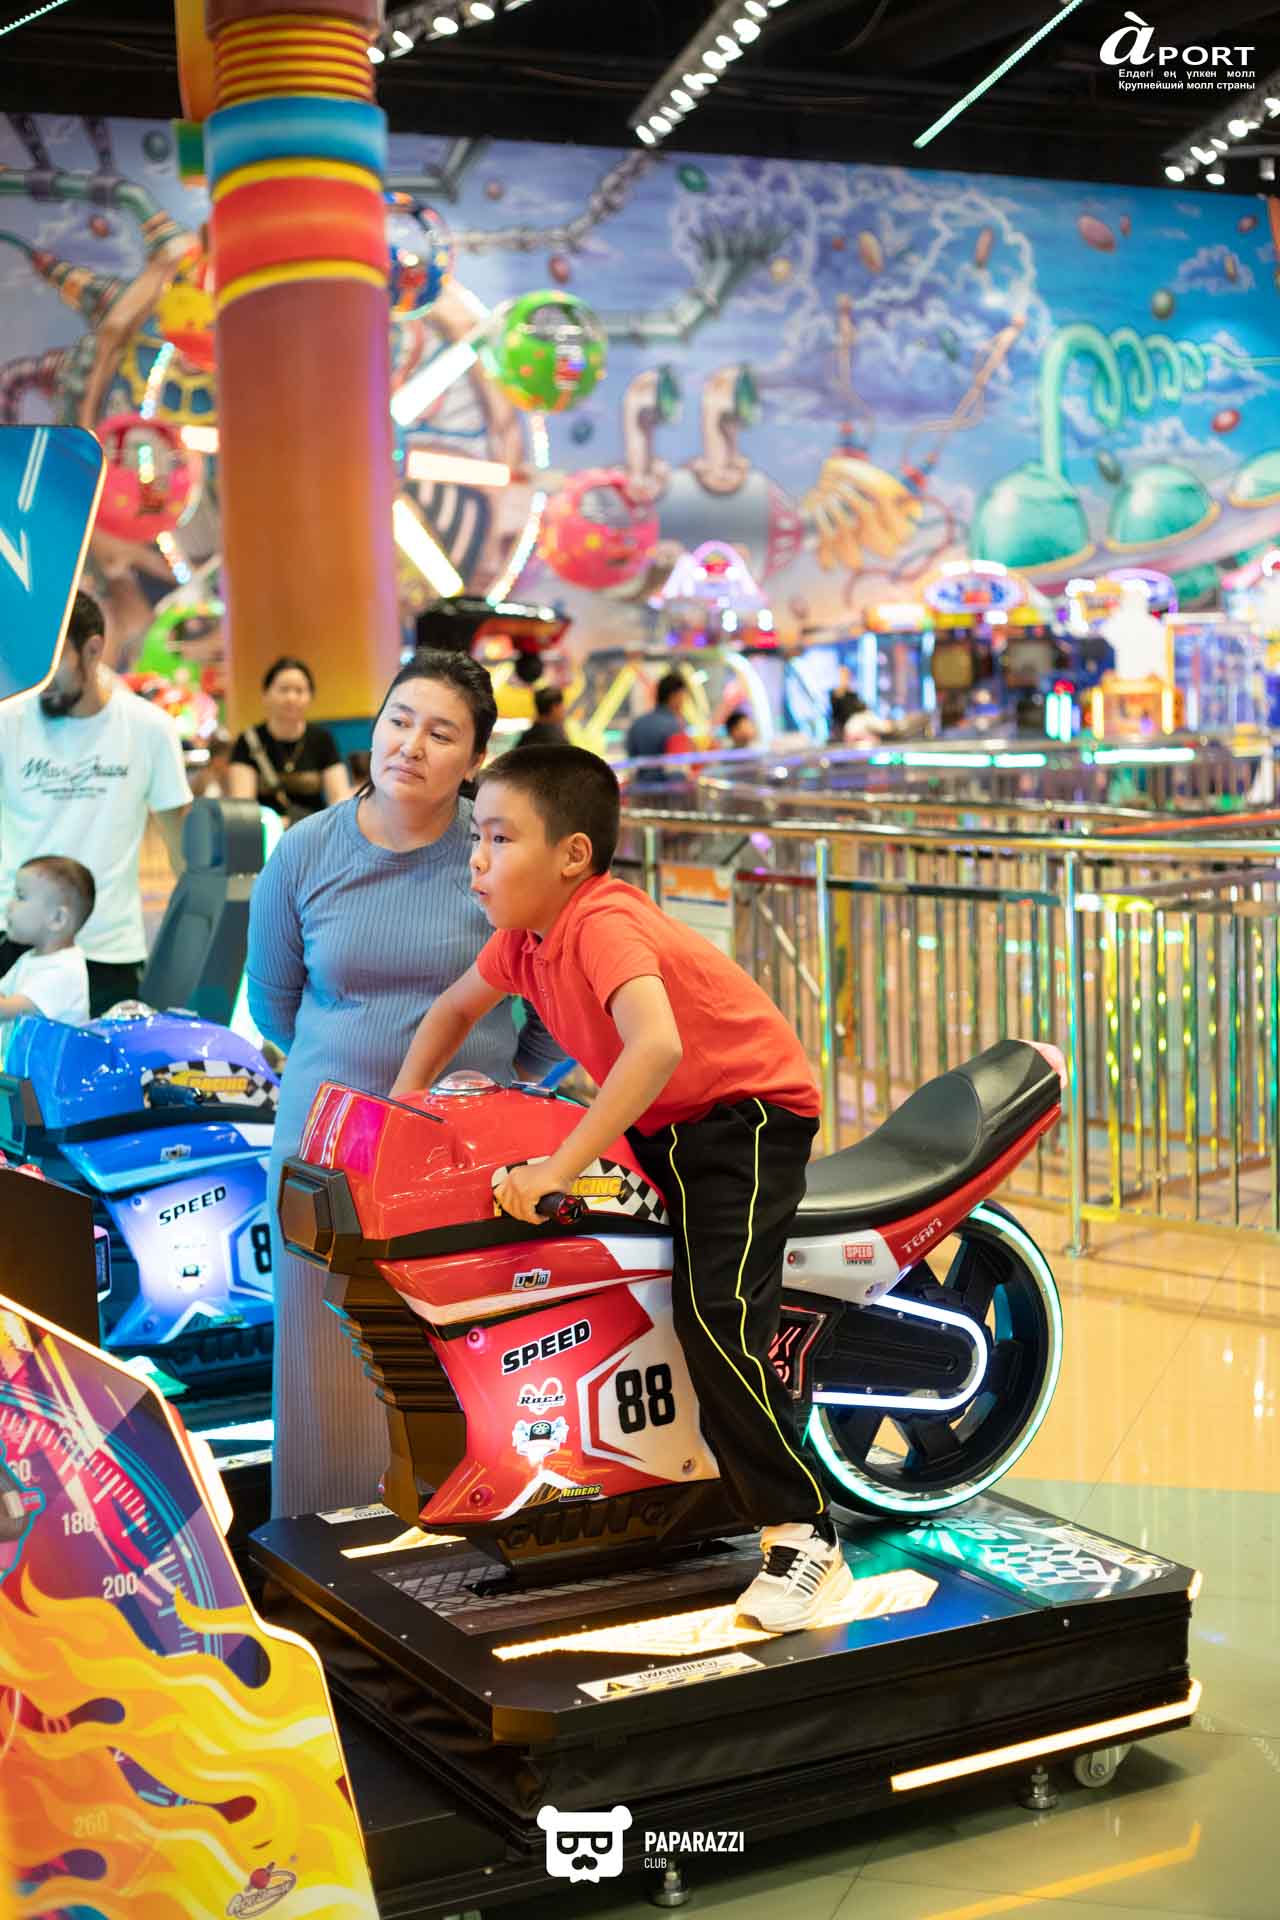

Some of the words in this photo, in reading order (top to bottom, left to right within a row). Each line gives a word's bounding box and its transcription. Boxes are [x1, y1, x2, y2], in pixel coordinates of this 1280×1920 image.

[159, 1186, 227, 1226] SPEED
[902, 1217, 942, 1253] TEAM
[502, 1320, 591, 1374] SPEED
[519, 1395, 564, 1405] Race
[615, 1363, 676, 1434] 88
[61, 1511, 96, 1536] 180
[102, 1573, 138, 1599] 200
[73, 1811, 109, 1838] 260
